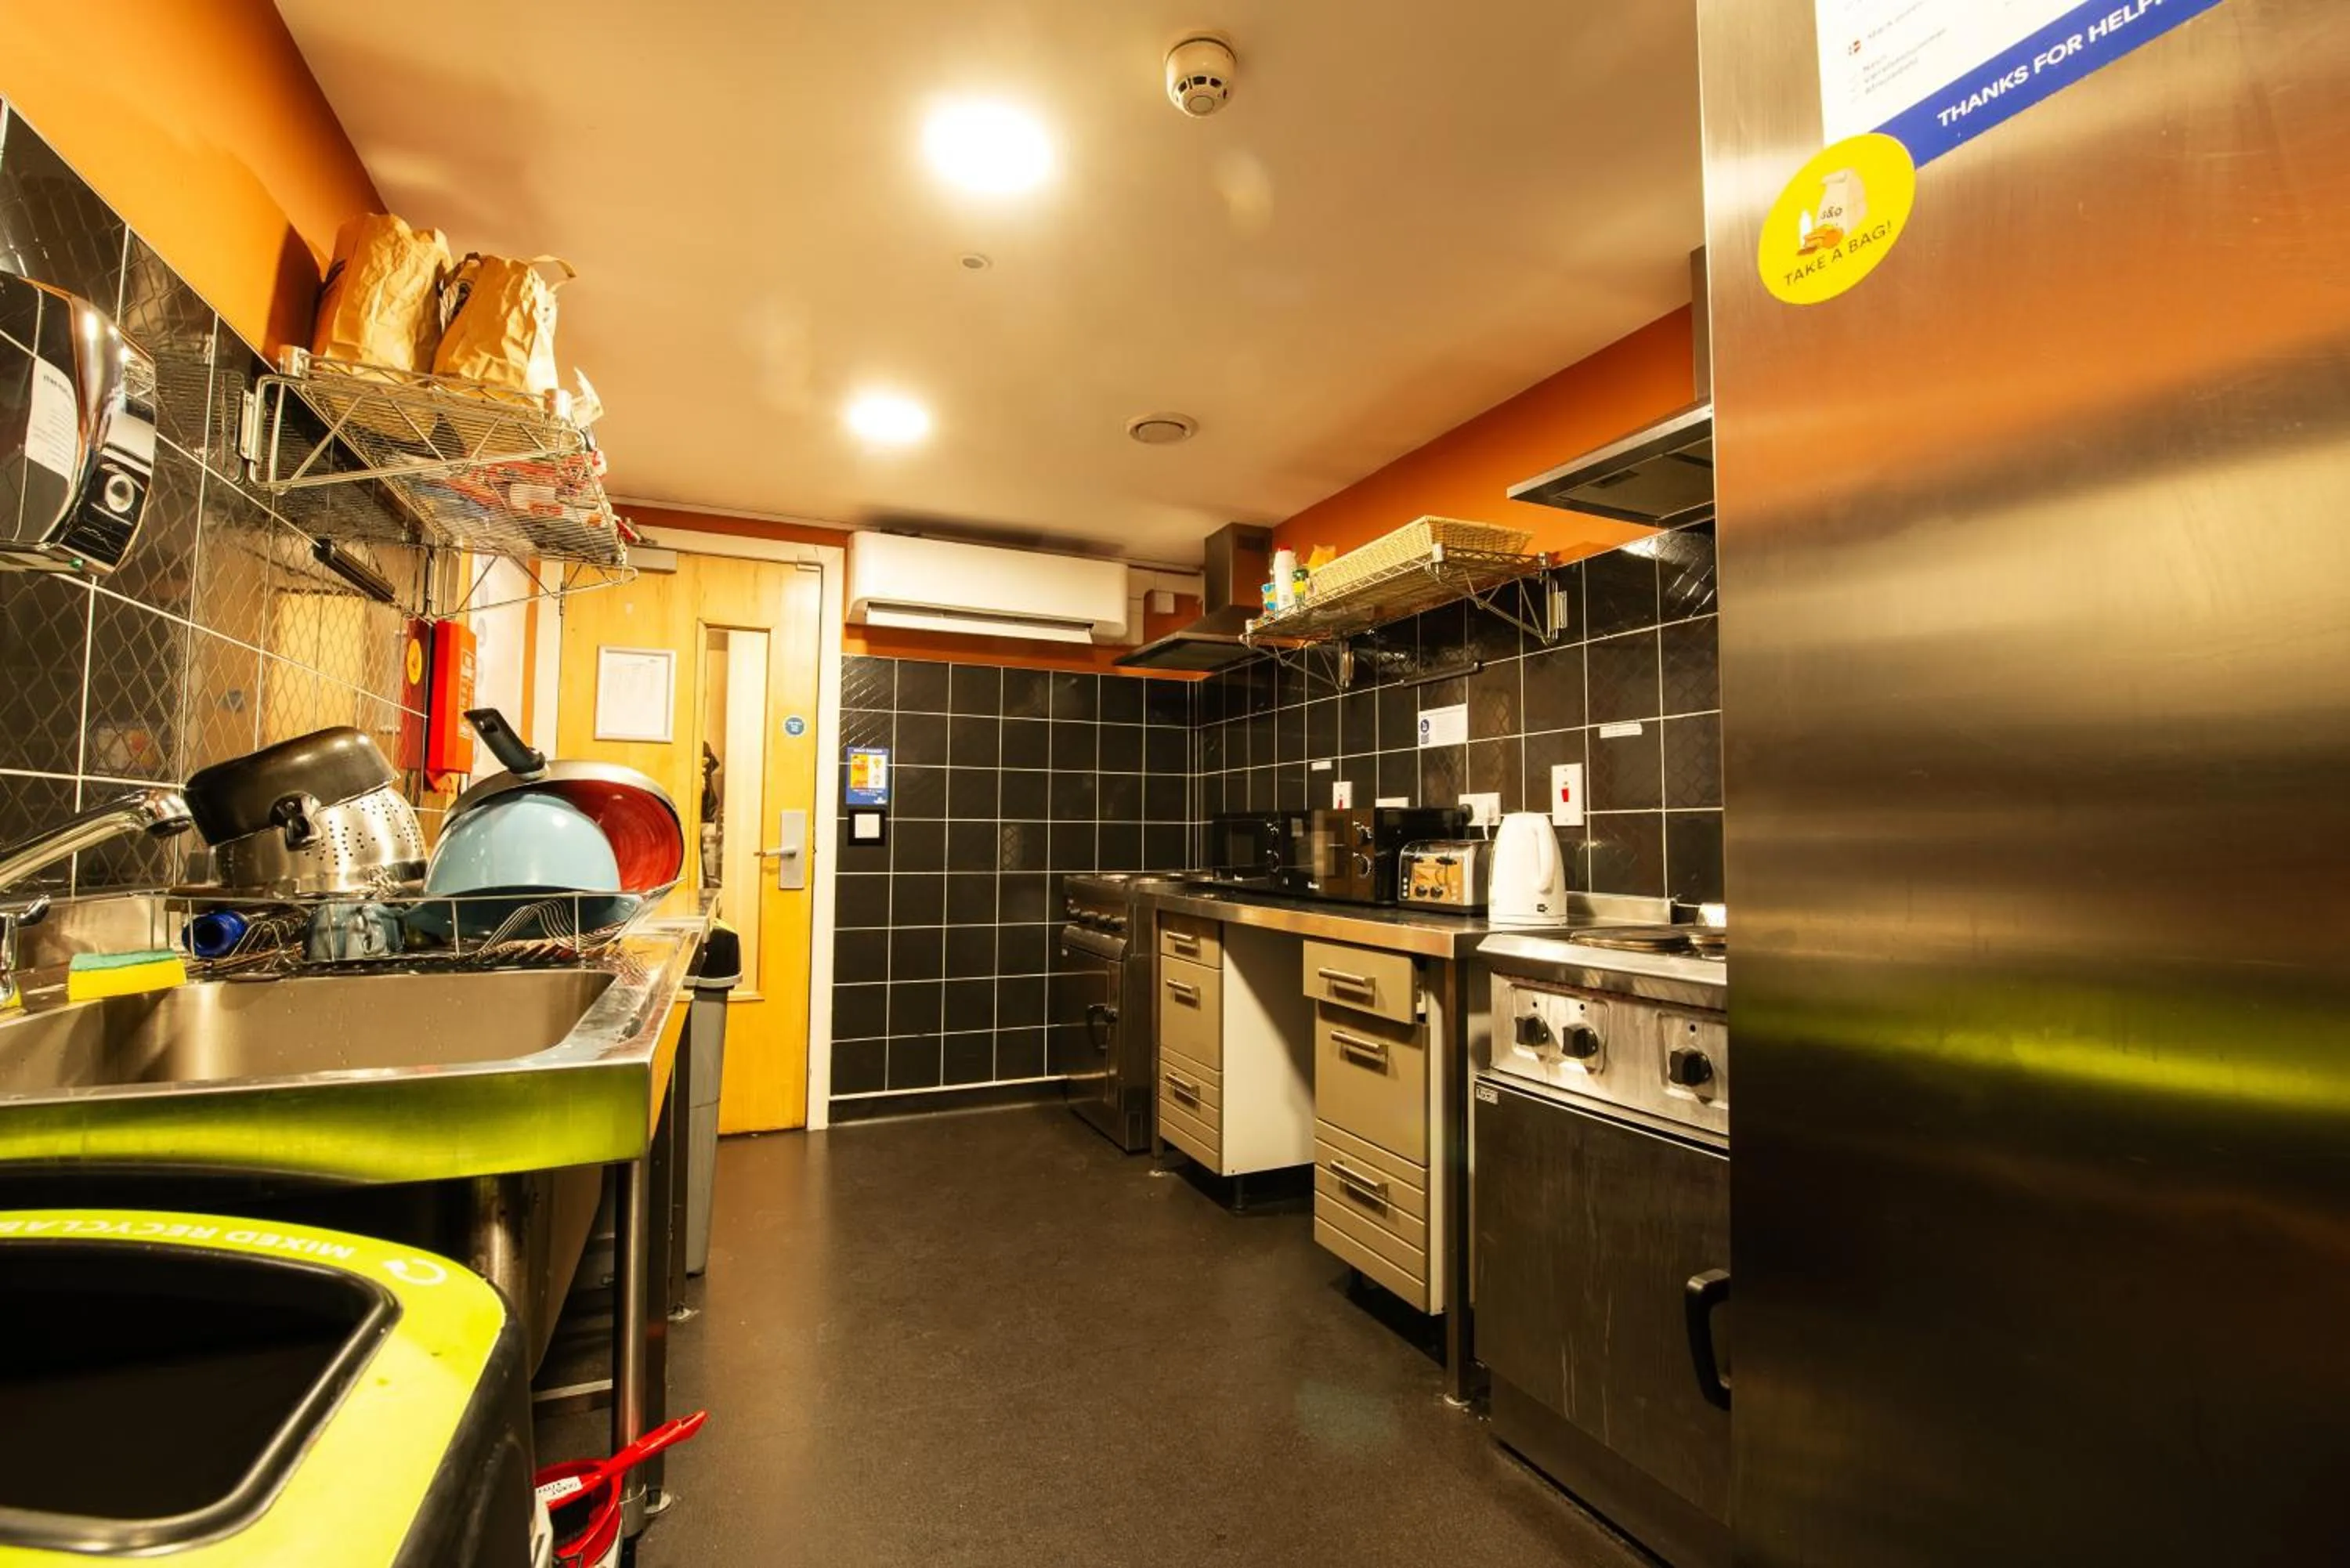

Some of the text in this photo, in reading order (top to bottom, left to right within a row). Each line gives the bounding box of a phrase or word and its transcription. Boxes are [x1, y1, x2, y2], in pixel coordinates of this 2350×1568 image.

[1936, 65, 2030, 127] THANKS
[2033, 34, 2083, 74] FOR
[2088, 0, 2163, 43] HELP
[1784, 219, 1892, 287] TAKE A BAG!
[225, 1230, 357, 1259] MIXED
